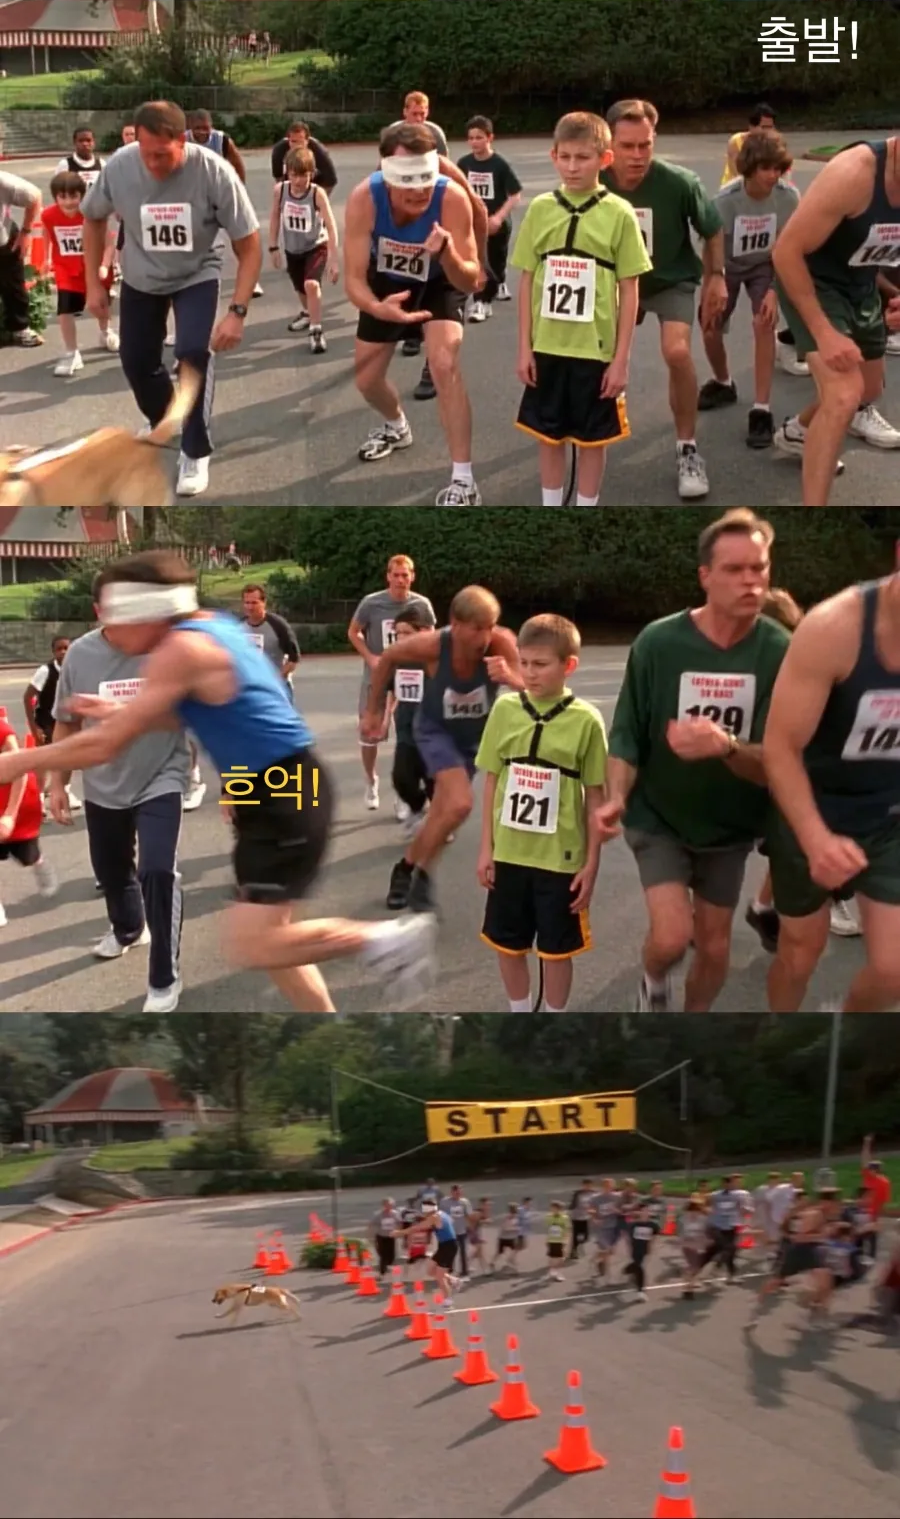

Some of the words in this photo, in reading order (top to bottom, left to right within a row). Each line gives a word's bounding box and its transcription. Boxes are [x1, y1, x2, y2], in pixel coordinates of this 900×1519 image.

[146, 224, 188, 246] 146
[287, 216, 306, 230] 111
[740, 232, 770, 251] 118
[383, 253, 424, 276] 120
[547, 283, 586, 316] 121
[860, 727, 900, 752] 14
[510, 792, 550, 827] 121
[446, 1101, 616, 1137] START
